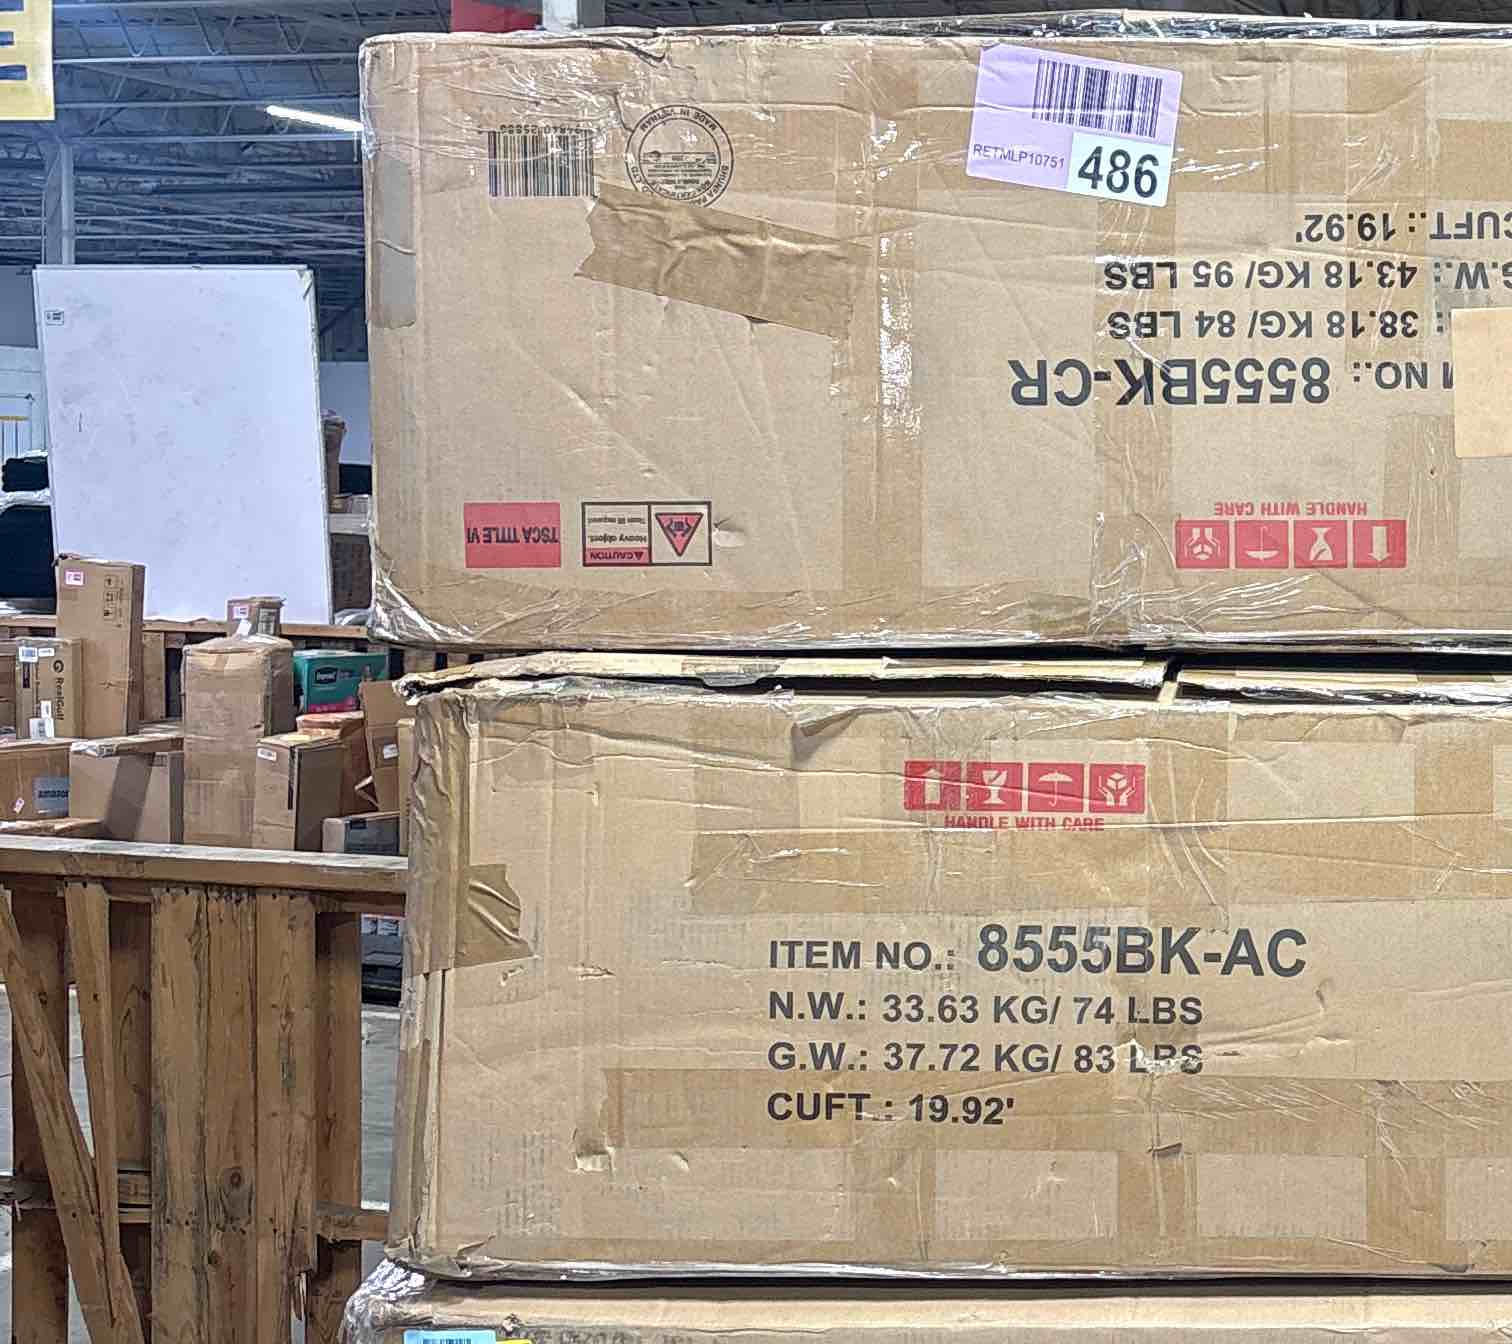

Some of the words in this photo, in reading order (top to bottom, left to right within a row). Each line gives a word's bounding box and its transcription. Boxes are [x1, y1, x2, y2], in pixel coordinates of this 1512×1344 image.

[973, 144, 1064, 169] RETMLP10751
[1078, 146, 1159, 198] 486
[1296, 212, 1397, 242] 19.92'
[1104, 261, 1177, 290] LBS
[1193, 261, 1234, 289] 95
[1246, 260, 1314, 291] KG/
[1326, 260, 1418, 289] 43.18
[1108, 310, 1181, 340] LBS
[1196, 311, 1236, 339] 84
[1248, 310, 1314, 341] KG/
[1328, 310, 1420, 339] 38.18
[1010, 358, 1331, 406] 8555BK-CR
[1353, 361, 1430, 391] NO.:
[1214, 501, 1256, 516] CARE
[1260, 501, 1300, 516] WITH
[1305, 501, 1368, 516] HANDLE
[467, 526, 480, 544] VI
[483, 526, 518, 544] TITLE
[523, 526, 559, 544] TSCA
[618, 534, 647, 544] Heavy
[590, 551, 634, 561] CAUTION
[945, 815, 1008, 832] HANDLE
[1016, 816, 1057, 832] WITH
[1062, 816, 1105, 832] CARE
[769, 941, 863, 971] ITEM
[876, 941, 956, 972] NO.:
[977, 923, 1308, 978] 8555BK-AC
[768, 992, 867, 1022] N.W.:
[882, 993, 980, 1024] 33.63
[993, 993, 1060, 1026] KG/
[1073, 996, 1115, 1025] 74
[1128, 996, 1202, 1026] LBS
[767, 1043, 867, 1073] G.W.:
[884, 1043, 981, 1074] 37.72
[995, 1043, 1062, 1075] KG/
[1073, 1044, 1115, 1074] 83
[766, 1092, 895, 1122] CUFT.:
[907, 1093, 1016, 1126] 19.92'
